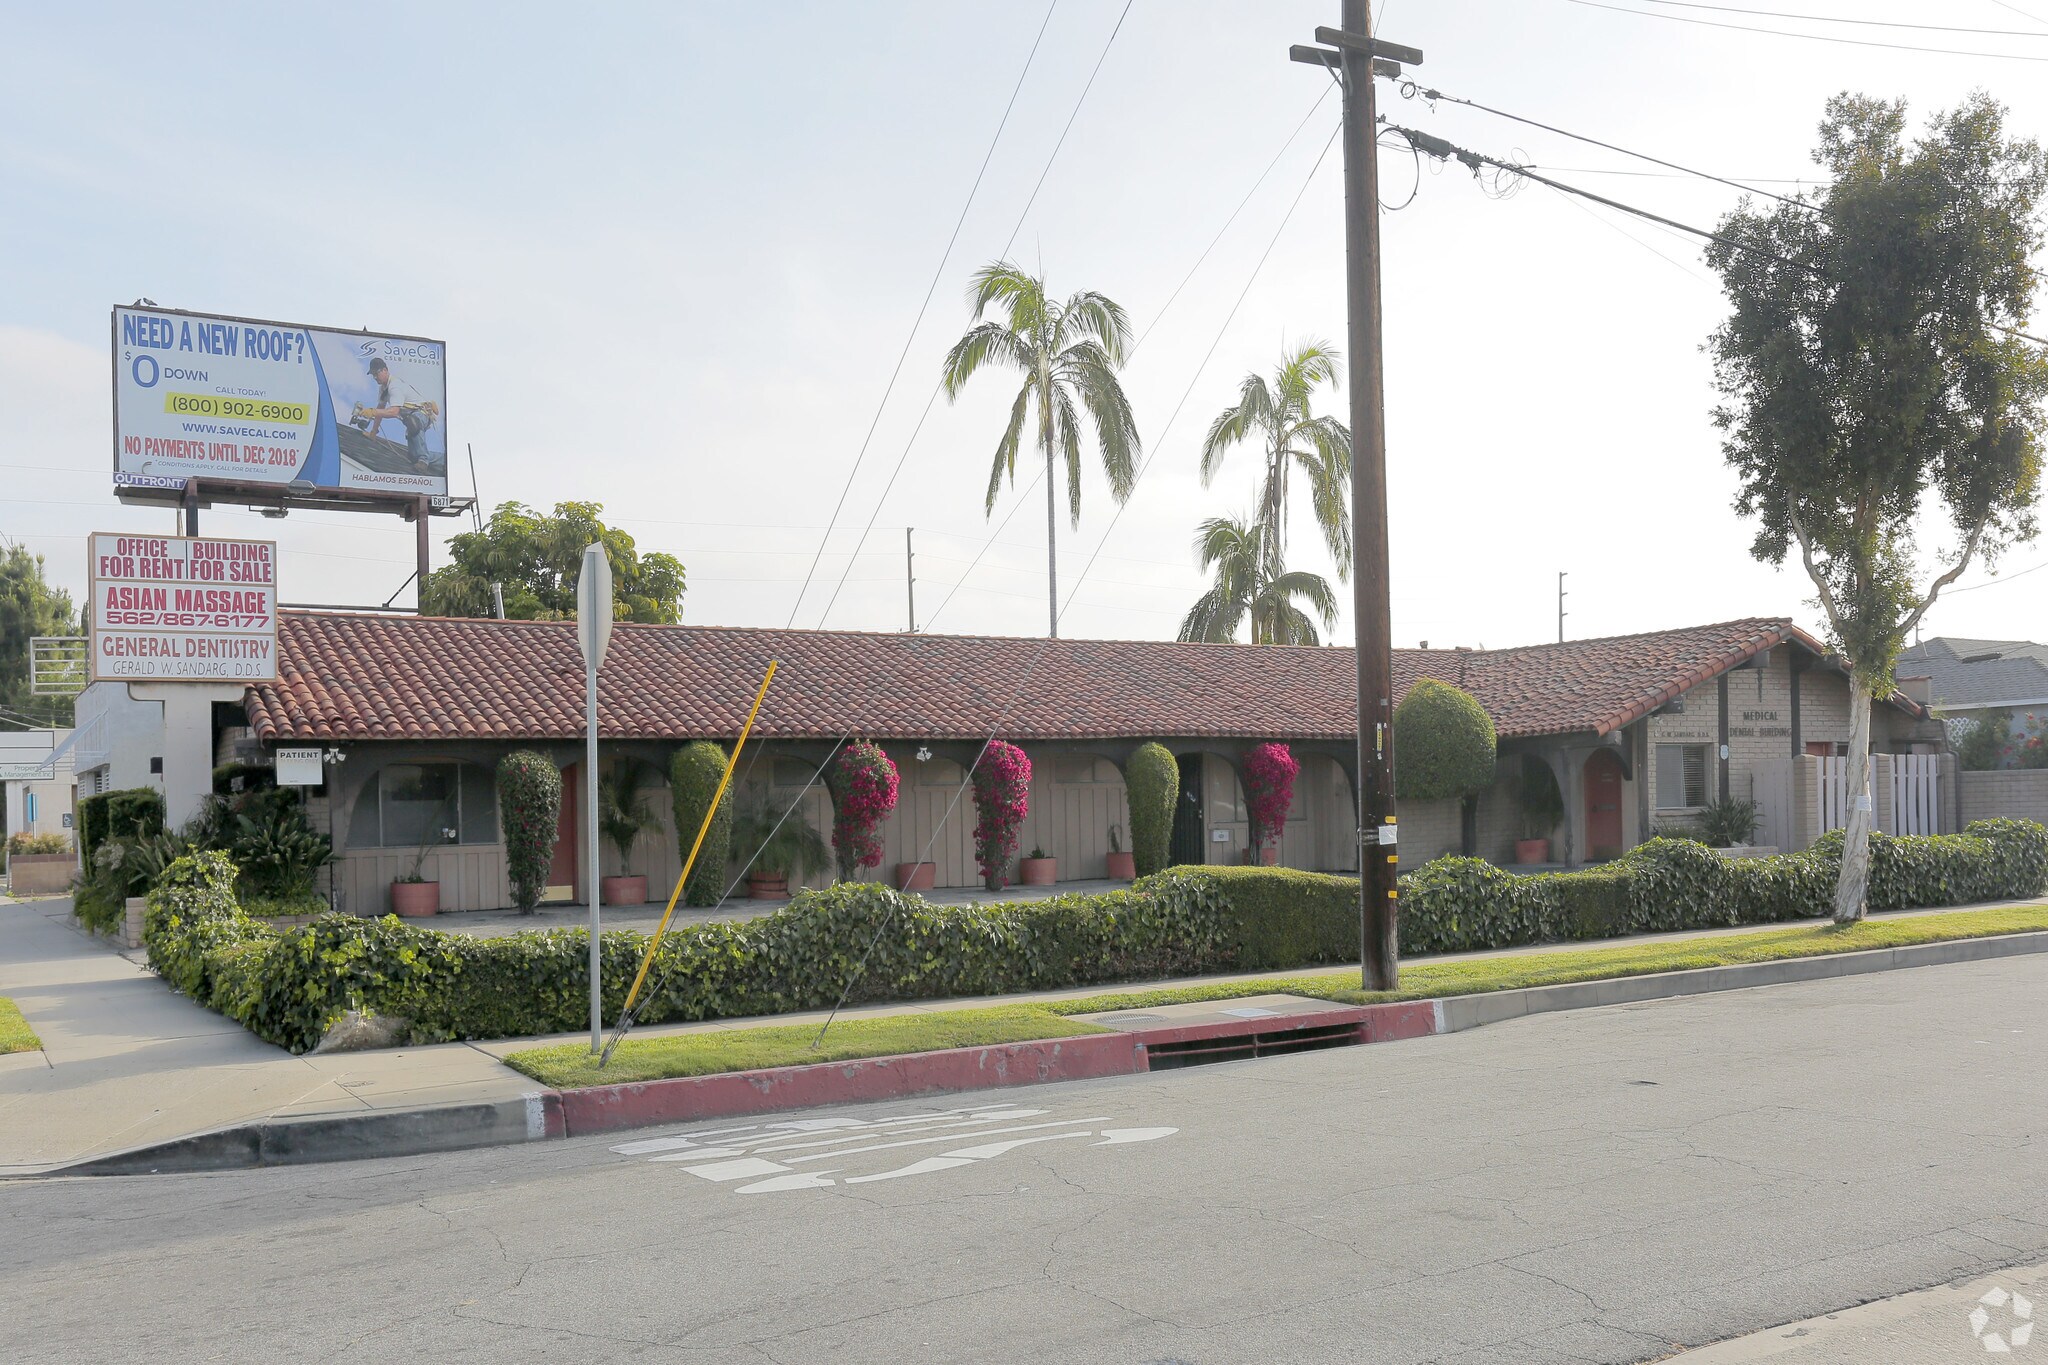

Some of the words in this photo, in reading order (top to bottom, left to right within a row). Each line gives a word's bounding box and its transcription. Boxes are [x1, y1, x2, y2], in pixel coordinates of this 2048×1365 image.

[123, 314, 174, 350] NEED
[179, 321, 193, 352] A
[198, 322, 239, 357] NEW
[244, 327, 305, 364] ROOF?
[384, 341, 440, 360] SaveCal
[164, 367, 208, 382] DOWN
[215, 386, 236, 395] CALL
[238, 387, 267, 397] TODAY!
[173, 396, 218, 416] (800)
[223, 401, 303, 421] 902-6900
[182, 423, 296, 440] WWW.SAVECAL.COM
[124, 435, 142, 456] NO
[144, 437, 206, 460] PAYMENTS
[208, 442, 241, 463] UNTIL
[243, 445, 265, 465] DEC
[115, 474, 184, 488] OUTFRONT
[352, 474, 397, 484] HABLAMOS
[398, 476, 433, 486] ESPAÑOL
[117, 538, 168, 558] OFFICE
[193, 542, 269, 562] BUILDING
[100, 556, 135, 578] FOR
[140, 557, 184, 579] RENT
[190, 560, 225, 580] FOR
[230, 561, 272, 583] SALE
[106, 587, 167, 611] ASIAN
[175, 589, 266, 614] MASSAGE
[106, 611, 270, 628] 562/867-6177
[102, 636, 181, 658] GENERAL
[185, 638, 270, 659] DENTISTRY
[113, 661, 155, 675] GERALD
[161, 661, 174, 675] W.
[177, 662, 229, 678] SANDARG,
[235, 663, 264, 677] D.D.S.
[1743, 711, 1778, 721] MEDICAL
[1729, 727, 1755, 737] DENTAL
